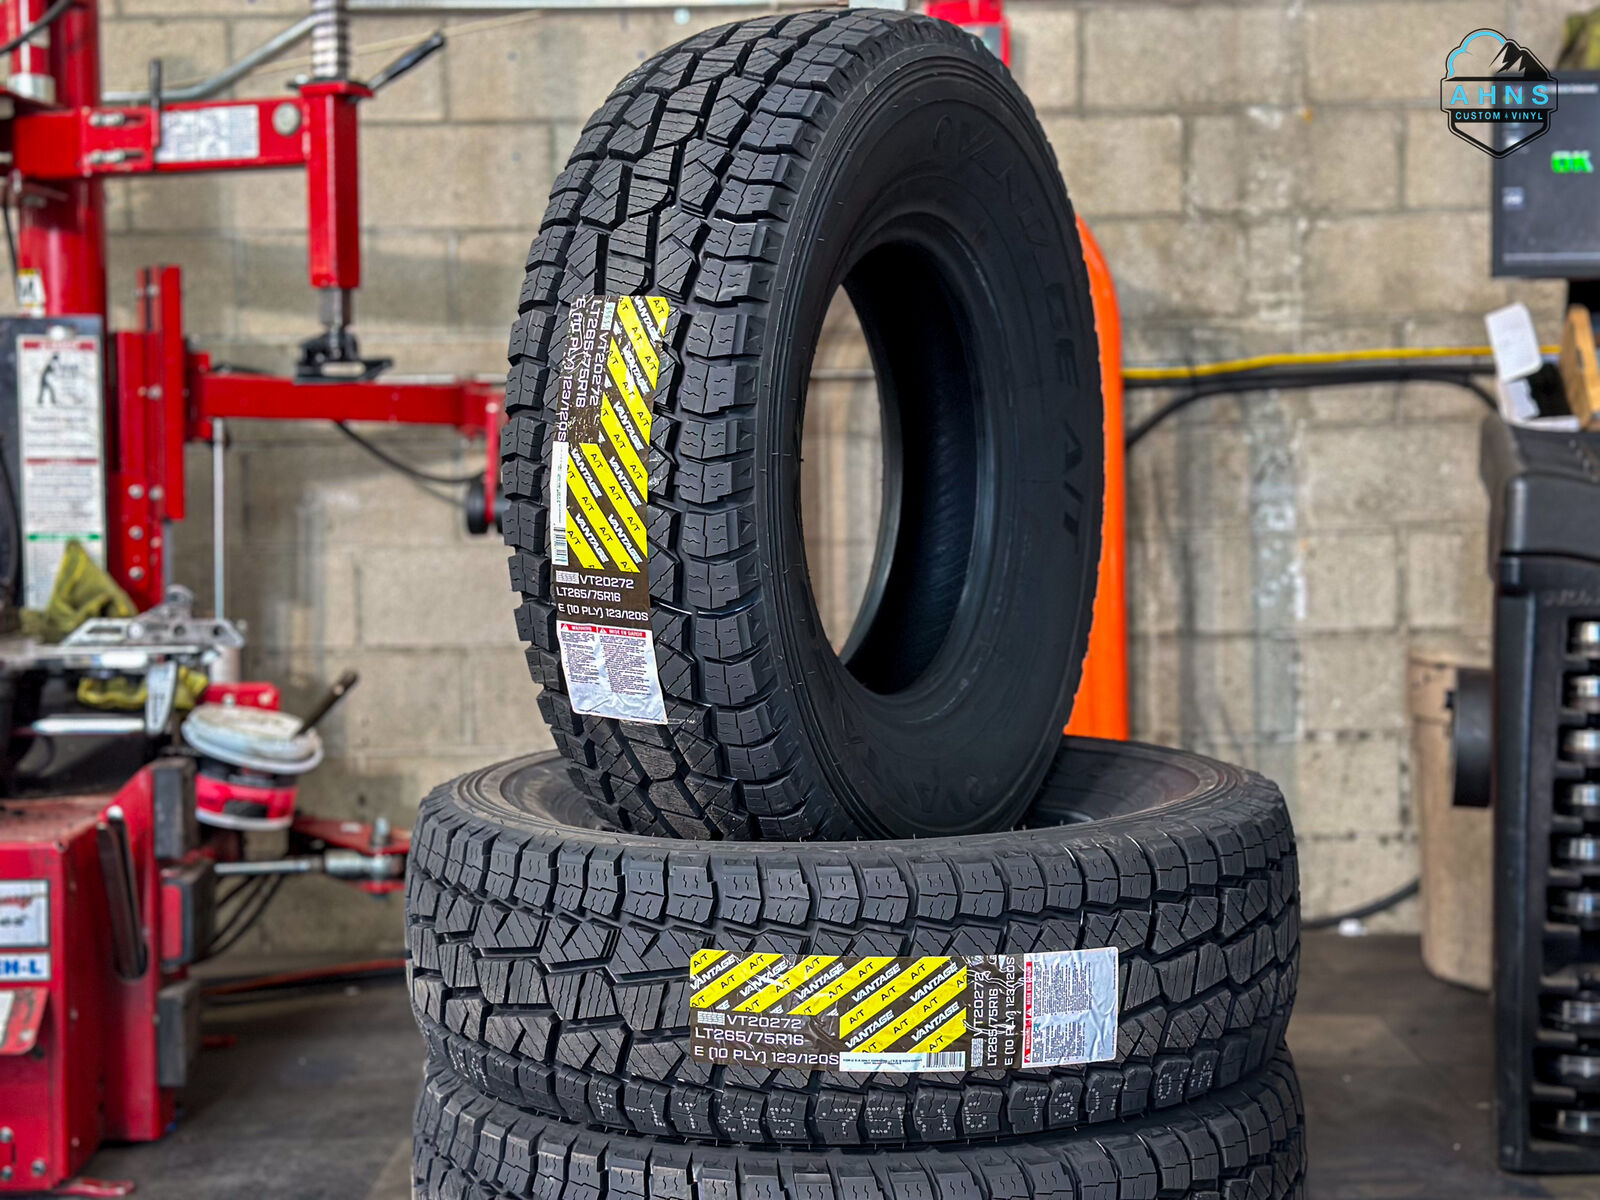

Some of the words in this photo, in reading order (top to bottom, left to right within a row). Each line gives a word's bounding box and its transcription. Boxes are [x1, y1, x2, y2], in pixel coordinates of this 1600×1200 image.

[653, 299, 664, 313] A/T
[575, 300, 602, 407] LT265/75R16
[631, 326, 642, 341] A/T
[644, 355, 657, 371] A/T
[589, 332, 609, 406] VT20272
[557, 374, 573, 442] 123/120S
[613, 400, 644, 451] VANTAGE
[637, 411, 649, 427] A/T
[613, 434, 626, 449] A/T
[629, 464, 643, 480] A/T
[591, 453, 603, 468] A/T
[609, 485, 623, 501] A/T
[627, 516, 641, 532] A/T
[609, 456, 642, 507] VANTAGE
[571, 448, 602, 498] VANTAGE
[608, 513, 643, 564] VANTAGE
[582, 496, 595, 512] A/T
[599, 526, 613, 542] A/T
[567, 530, 581, 545] A/T
[575, 512, 610, 563] VANTAGE
[555, 586, 621, 602] LT265/75R16
[579, 574, 634, 589] VT20272
[558, 603, 565, 612] E
[566, 604, 579, 615] (10
[581, 606, 604, 618] PLY)
[605, 608, 649, 621] 123/120S
[690, 954, 736, 990] VANTAGE
[693, 953, 708, 968] A/T
[720, 974, 736, 989] A/T
[749, 954, 764, 970] A/T
[775, 977, 791, 993] A/T
[805, 957, 820, 973] A/T
[795, 962, 844, 1000] VANTAGE
[828, 983, 844, 999] A/T
[858, 962, 873, 978] A/T
[849, 1009, 865, 1024] A/T
[881, 986, 896, 1002] A/T
[910, 964, 926, 980] A/T
[851, 963, 901, 1002] VANTAGE
[1006, 957, 1015, 1007] 123/120S
[726, 1014, 802, 1029] VT20272
[844, 1010, 895, 1048] VANTAGE
[909, 962, 958, 1002] VANTAGE
[893, 1018, 909, 1034] A/T
[922, 996, 938, 1013] A/T
[911, 1001, 960, 1041] VANTAGE
[973, 973, 984, 1036] VT20272
[695, 1027, 804, 1045] LT265/75R16
[929, 1035, 944, 1051] A/T
[987, 988, 998, 1066] LT265/75R16
[1005, 1039, 1016, 1053] (10
[694, 1046, 704, 1056] E
[709, 1047, 728, 1060] (10
[733, 1050, 766, 1064] PLY)
[771, 1052, 839, 1065] 123/120S
[1005, 1058, 1013, 1066] E
